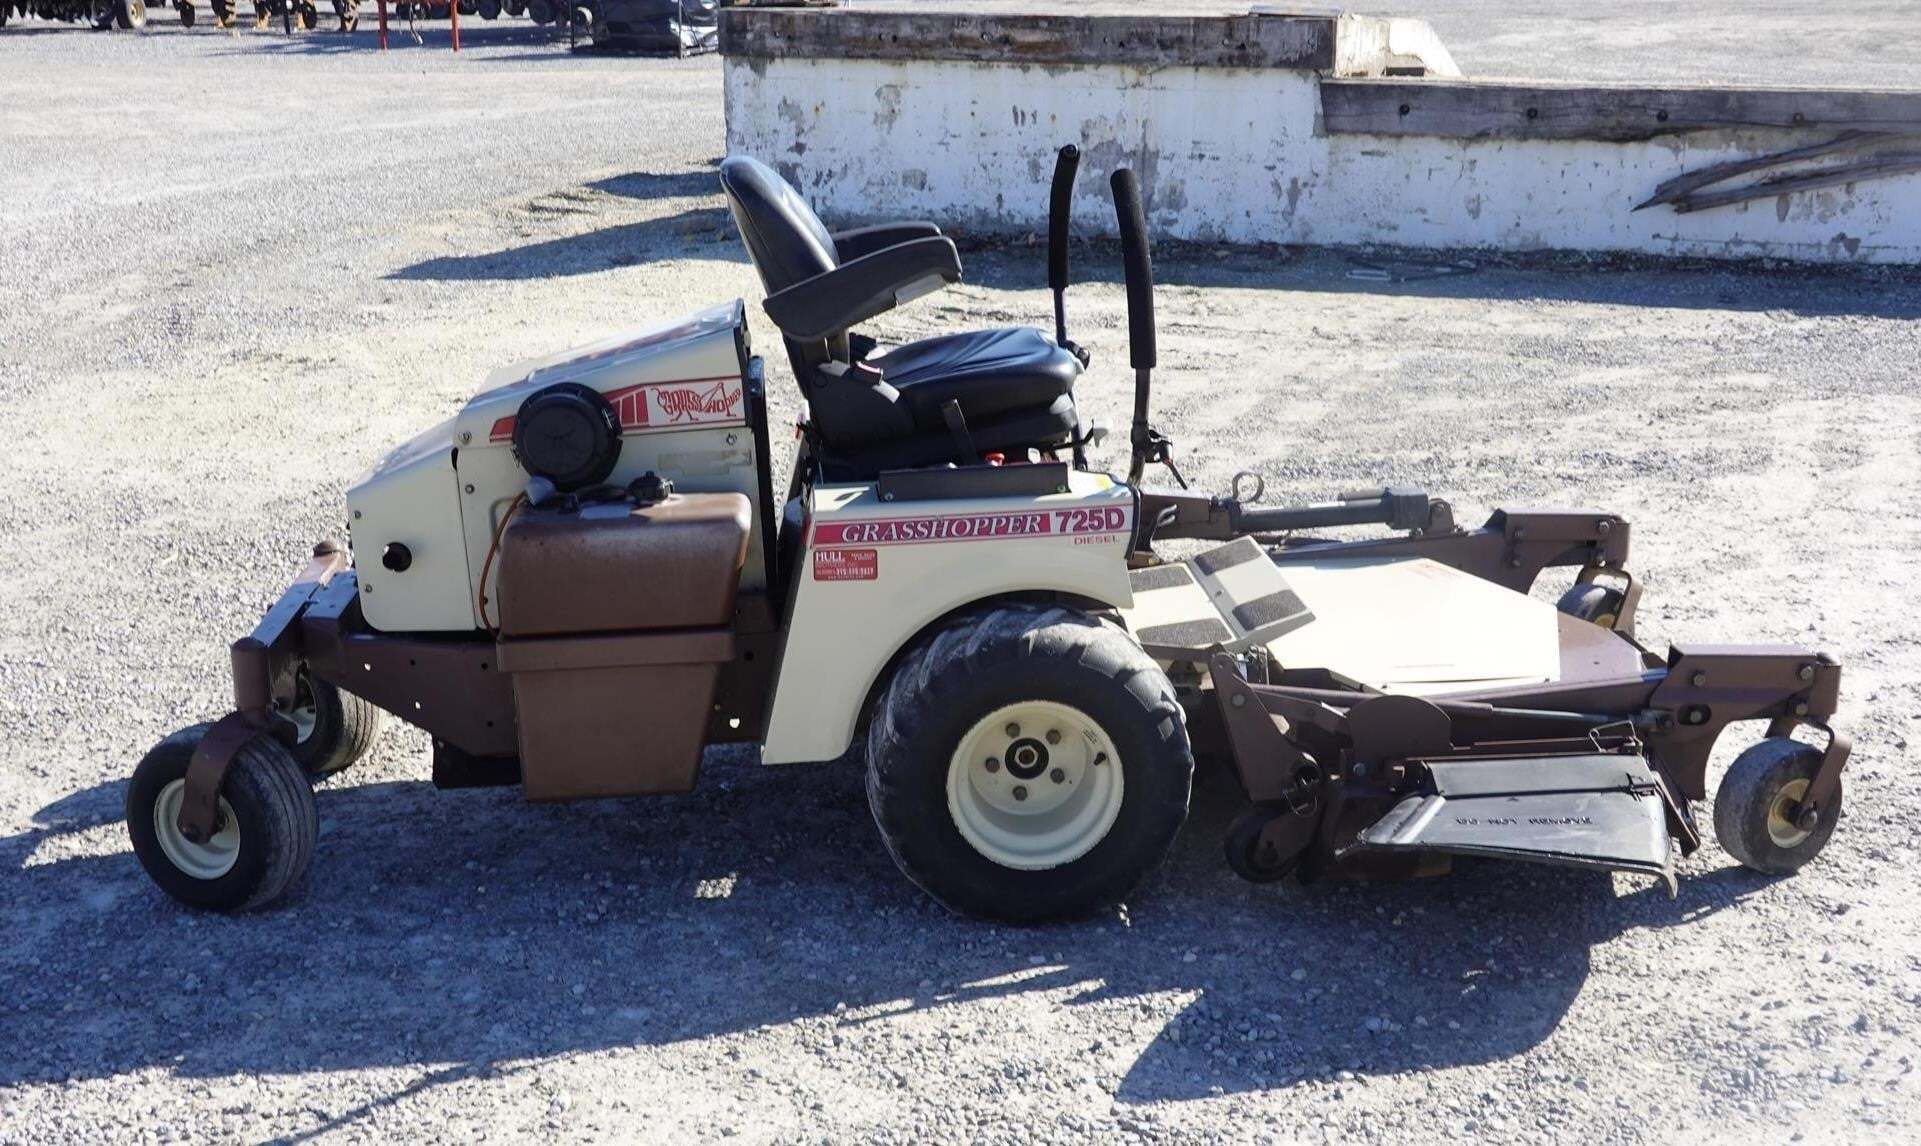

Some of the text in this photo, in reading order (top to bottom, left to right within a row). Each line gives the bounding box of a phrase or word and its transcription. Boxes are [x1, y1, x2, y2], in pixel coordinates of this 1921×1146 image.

[841, 507, 1125, 543] GRASSHOPPER 725D
[1074, 534, 1120, 545] DIESEL
[815, 551, 844, 562] HULL
